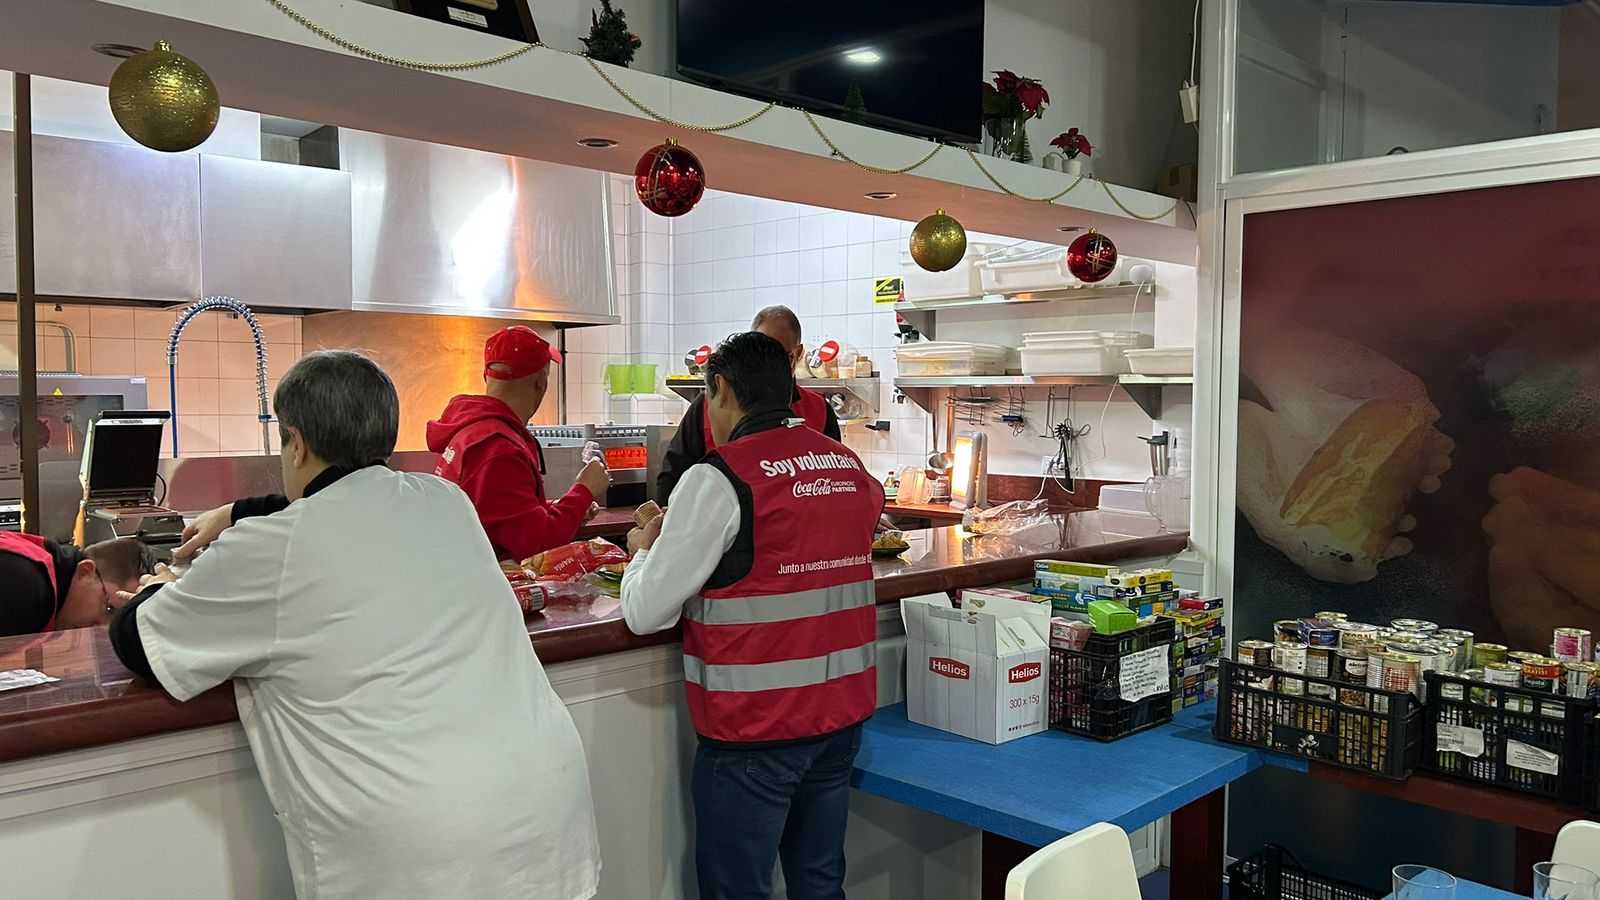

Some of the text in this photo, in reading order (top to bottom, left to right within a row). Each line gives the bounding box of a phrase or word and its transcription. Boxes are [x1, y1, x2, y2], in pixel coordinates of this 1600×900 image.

[760, 459, 796, 477] Soy
[778, 563, 800, 575] Junto
[800, 563, 805, 572] a
[829, 555, 854, 569] comunidad
[854, 554, 867, 565] desde
[932, 660, 967, 677] Helios
[1011, 667, 1040, 680] Helios
[1009, 697, 1022, 709] 300
[1029, 694, 1040, 705] 15g
